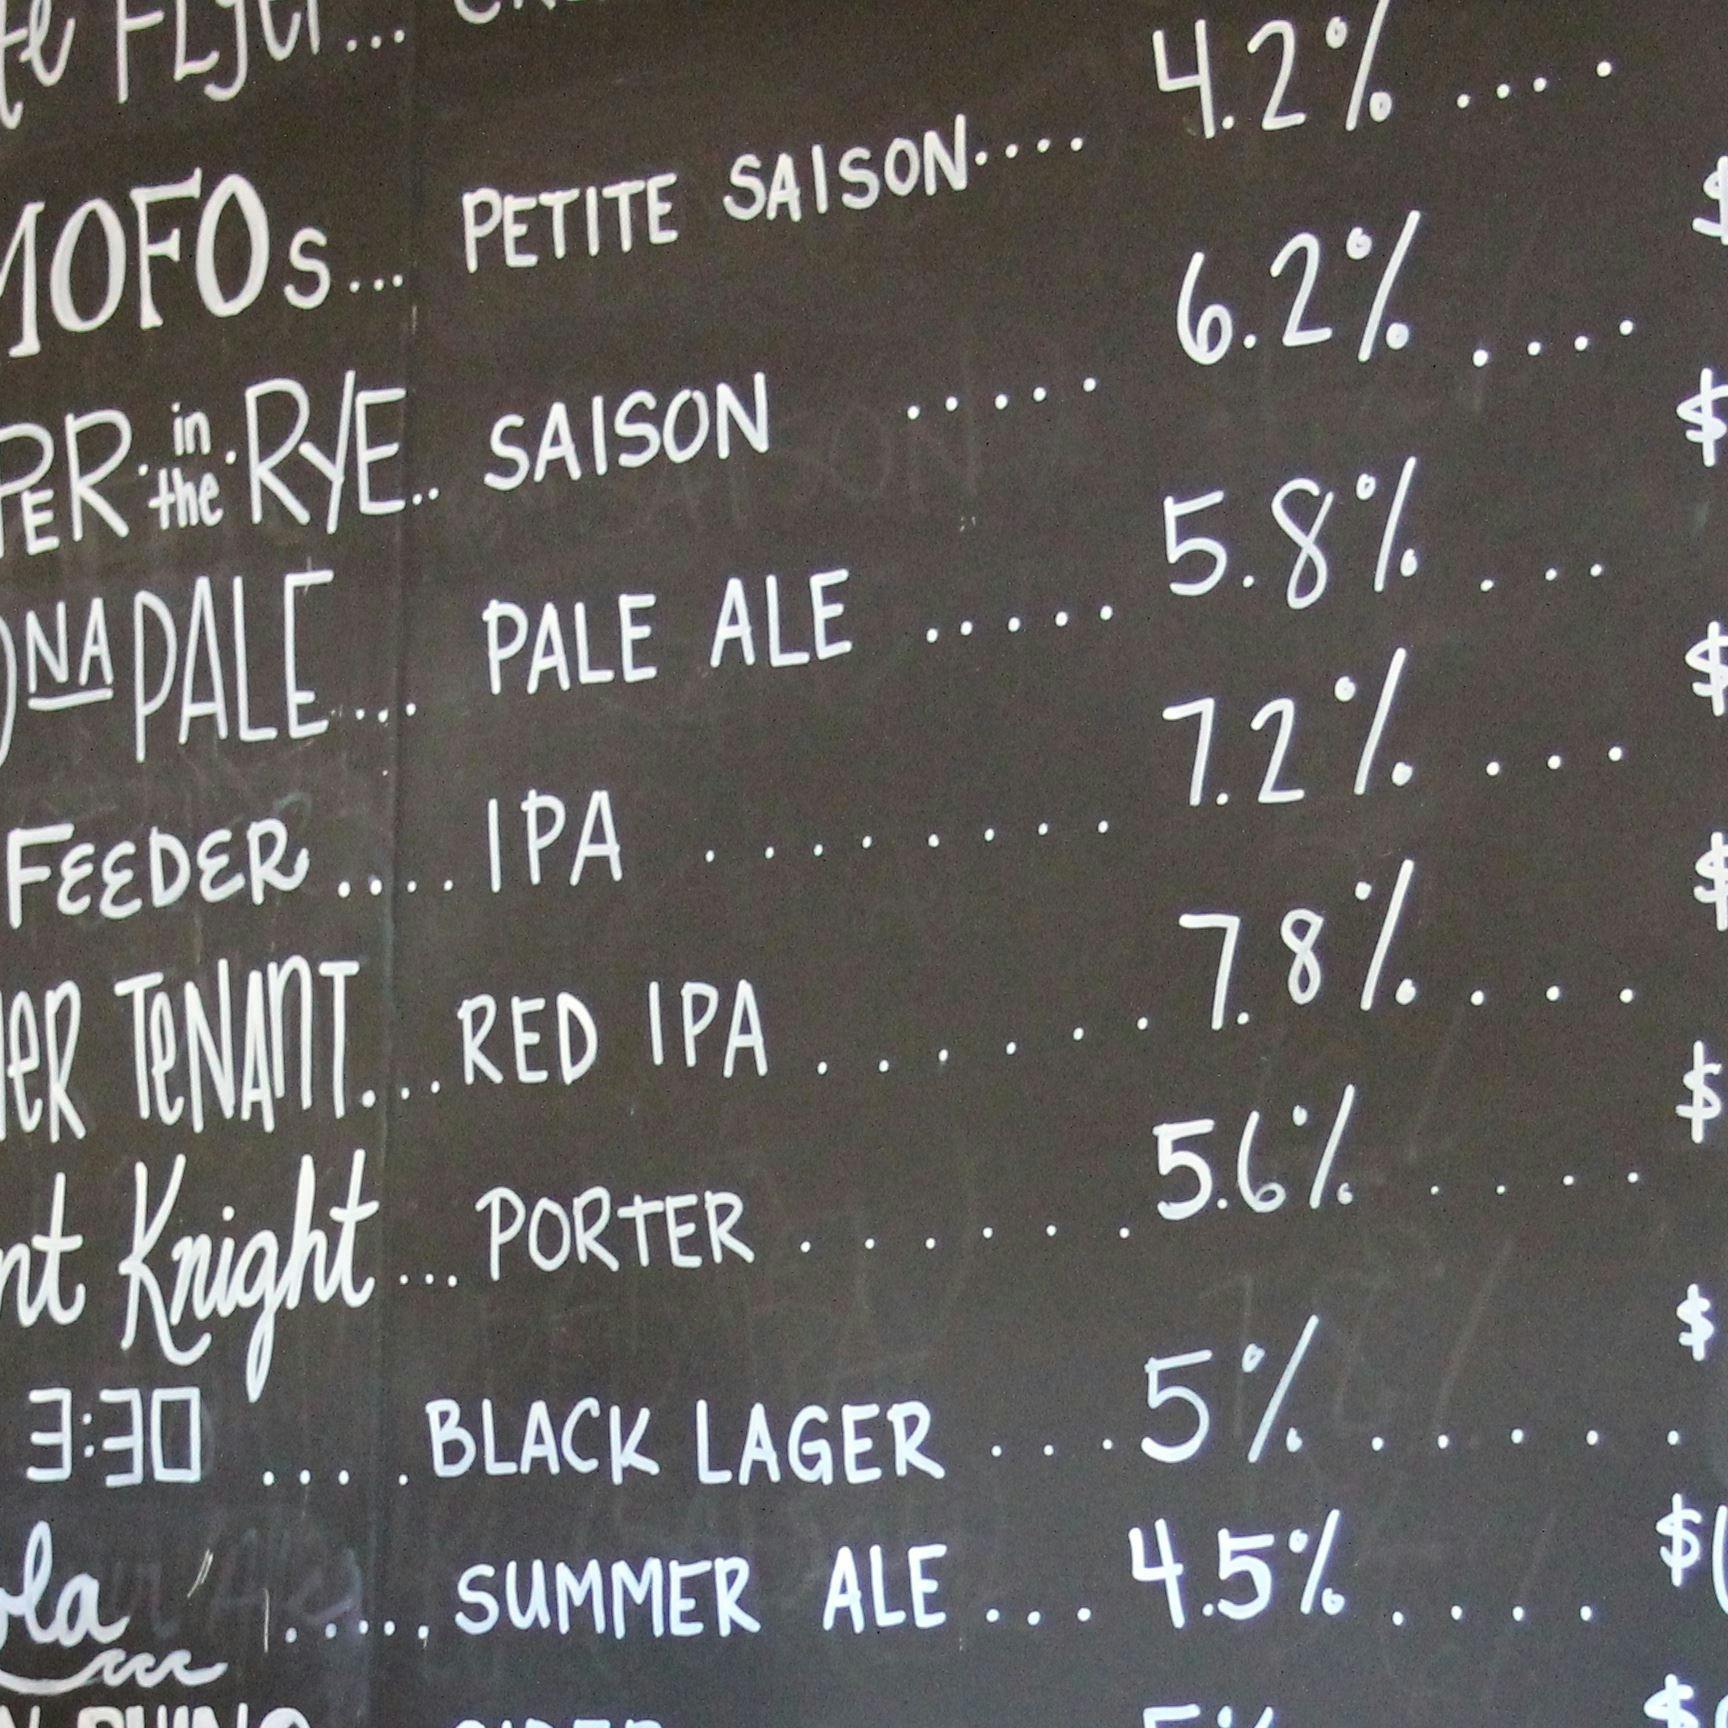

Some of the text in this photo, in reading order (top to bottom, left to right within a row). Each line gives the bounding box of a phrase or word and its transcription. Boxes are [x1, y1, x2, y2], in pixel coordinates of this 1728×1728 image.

[461, 171, 680, 274] PETITE
[721, 112, 969, 223] SAISON
[1151, 0, 1394, 140] 4.2%
[243, 369, 407, 535] RYE
[482, 370, 770, 492] SAISON
[1175, 209, 1422, 366] 6.2%
[132, 568, 335, 764] PALE
[481, 592, 658, 696] PALE
[709, 567, 854, 669] ALE
[1162, 455, 1419, 611] 5.8%
[5, 817, 311, 930] FEEDER
[487, 787, 624, 894] IPA
[1161, 646, 1414, 807] 7.2%
[455, 991, 599, 1086] RED
[647, 978, 769, 1079] IPA
[1177, 857, 1418, 1032] 7.8%
[114, 1145, 384, 1406] Knight
[474, 1185, 756, 1282] PORTER
[1151, 1083, 1357, 1222] 5.6%
[25, 1385, 203, 1488] 3:30
[424, 1396, 661, 1486] BLACK
[695, 1398, 947, 1487] LAGER
[1140, 1313, 1321, 1464] 5%
[454, 1555, 762, 1641] SUMMER
[822, 1542, 949, 1635] ALE
[1127, 1507, 1347, 1630] 4.5%
